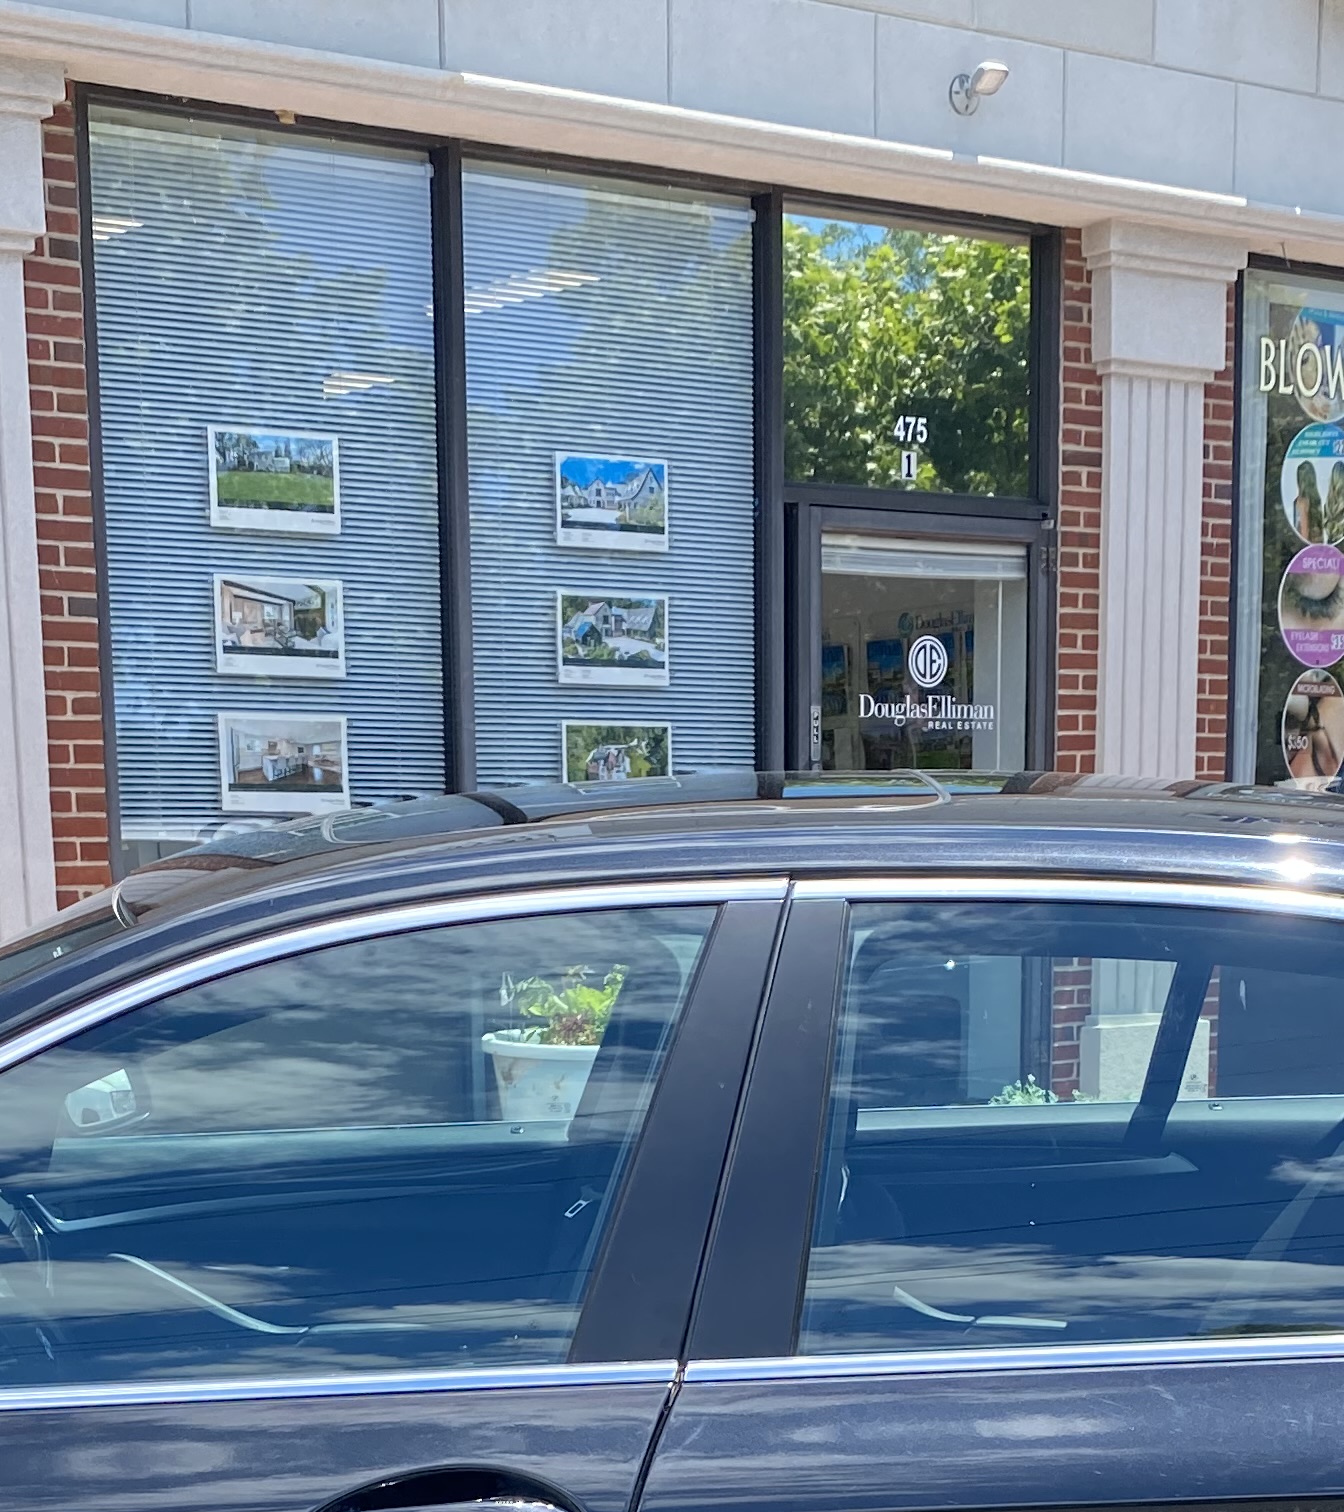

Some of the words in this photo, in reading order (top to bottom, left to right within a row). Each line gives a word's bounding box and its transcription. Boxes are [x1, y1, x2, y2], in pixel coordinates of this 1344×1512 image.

[893, 415, 928, 444] 475
[904, 453, 914, 478] 1
[927, 721, 954, 730] REAL
[956, 721, 994, 731] ESTATE
